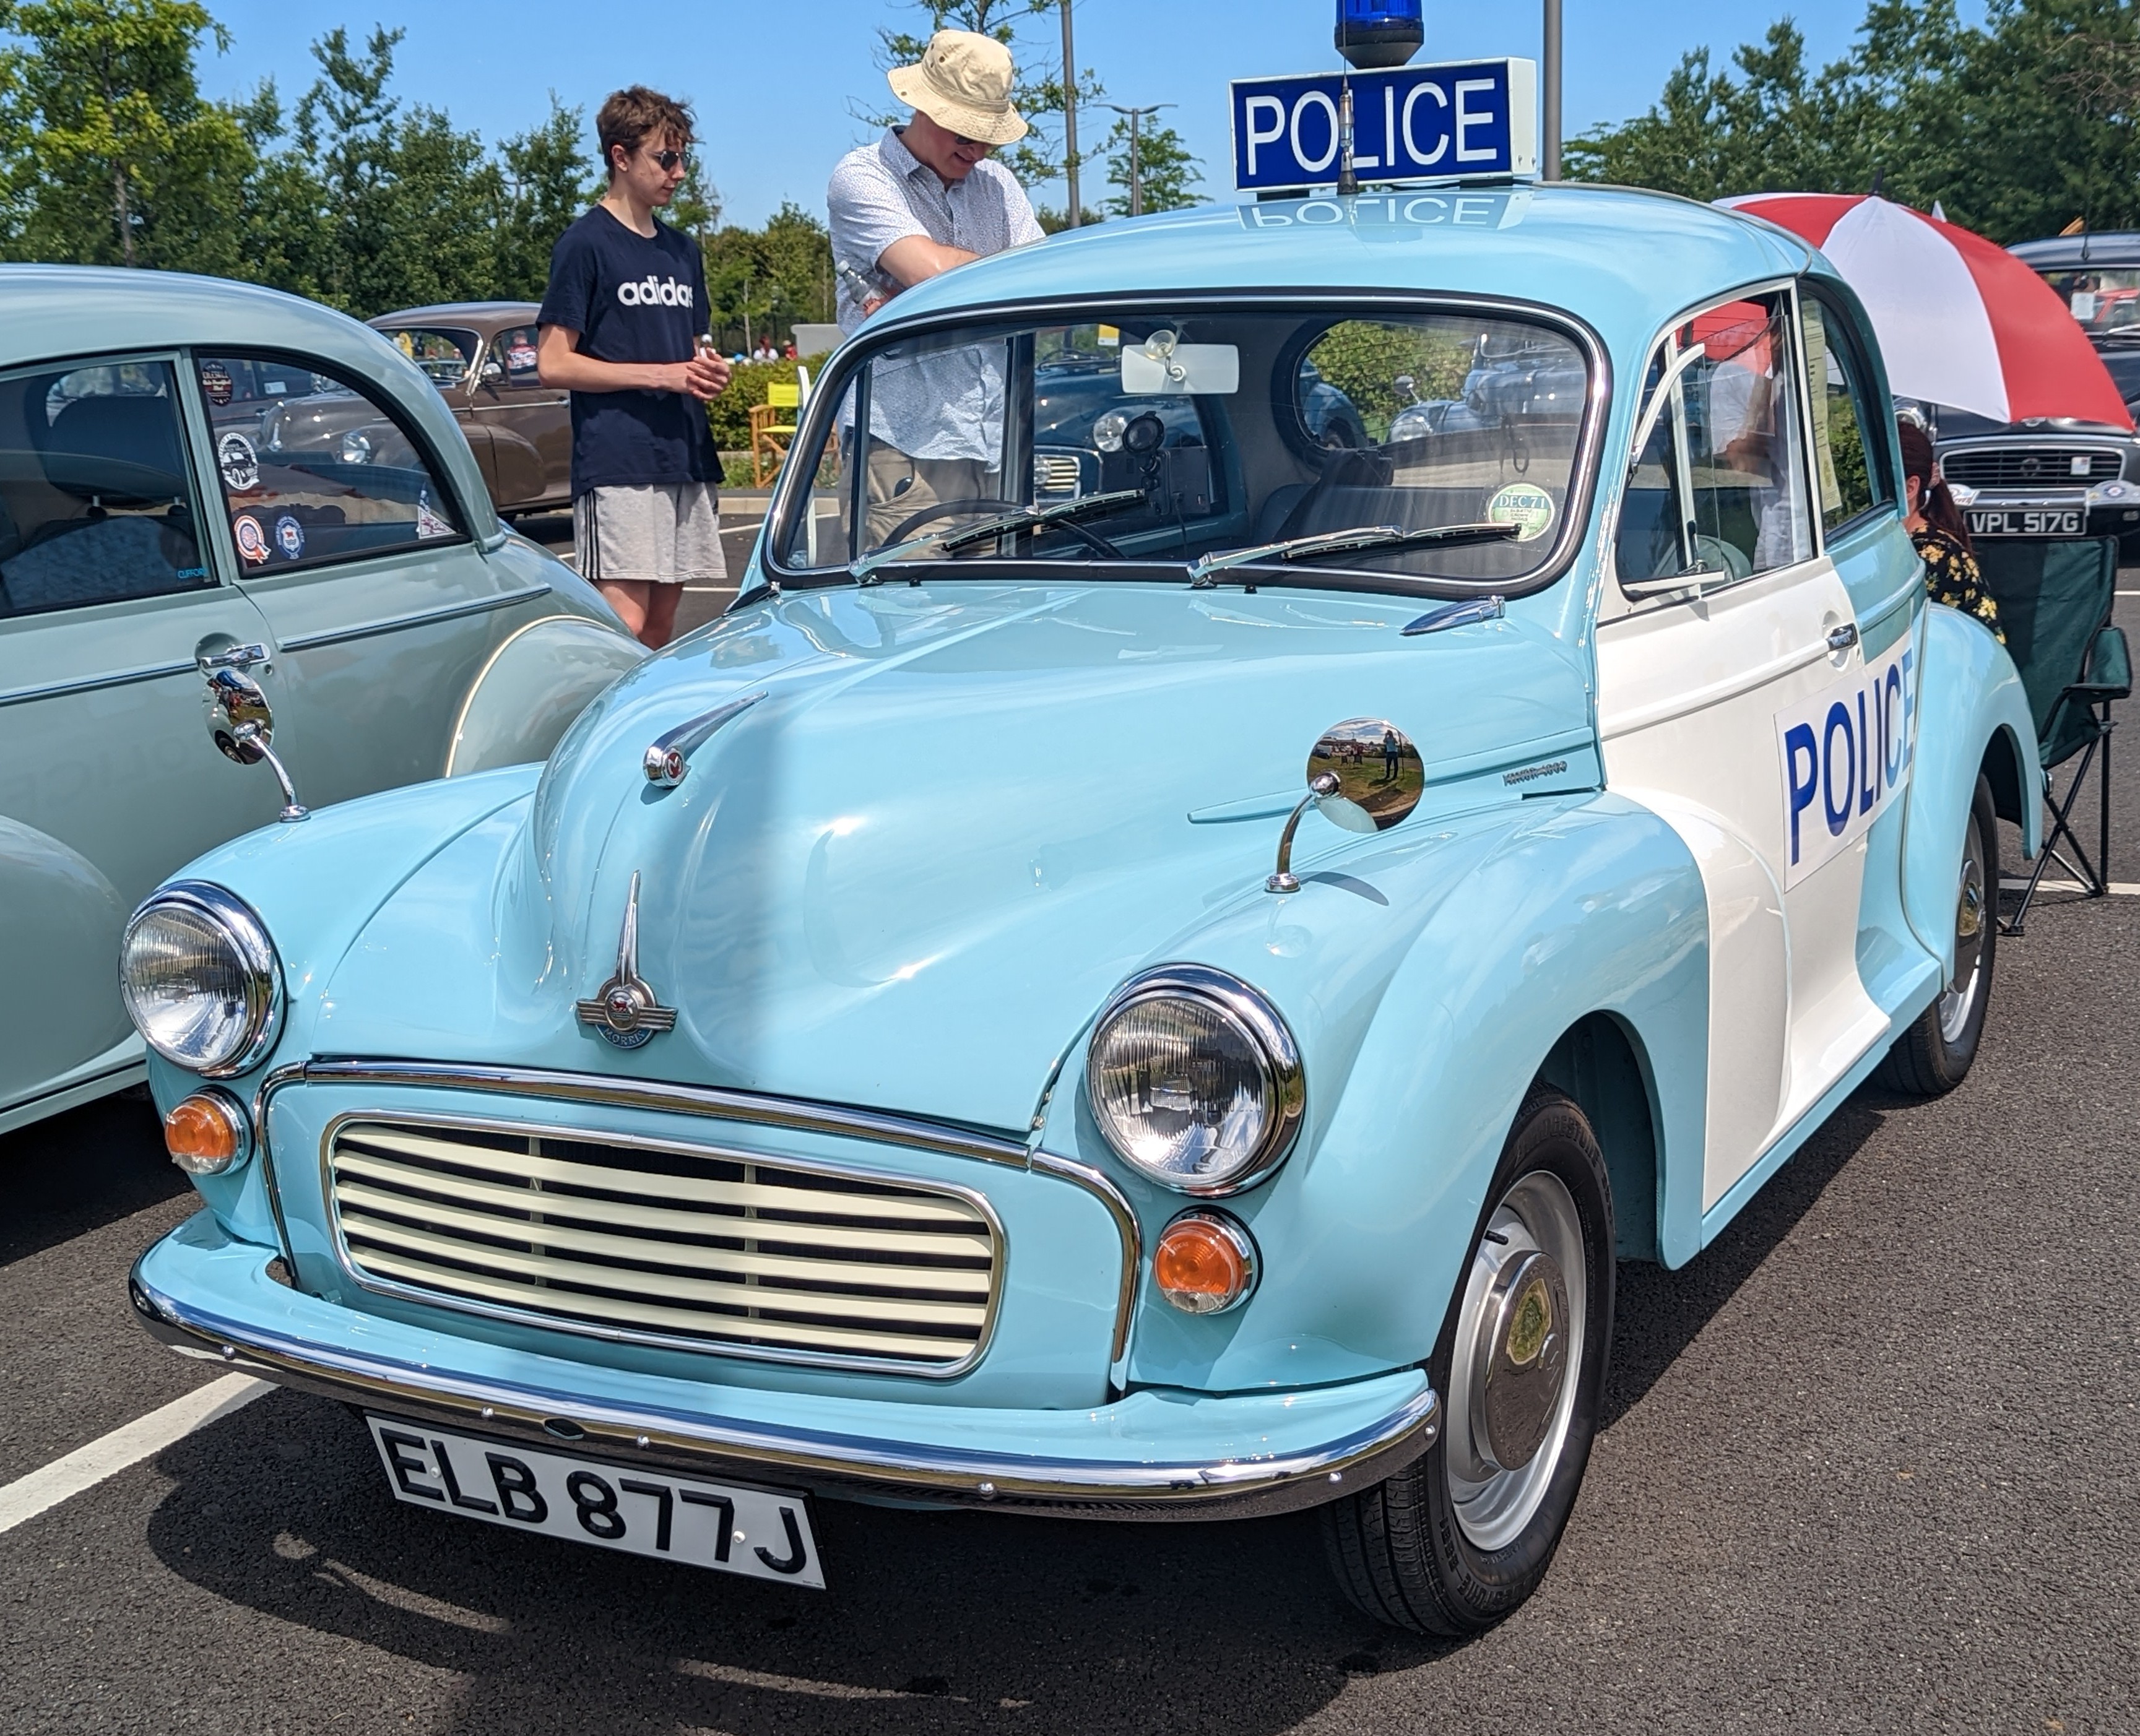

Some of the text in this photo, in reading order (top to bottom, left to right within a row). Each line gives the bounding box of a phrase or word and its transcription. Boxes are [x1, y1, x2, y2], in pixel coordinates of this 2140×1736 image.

[1245, 78, 1497, 176] POLICE
[1499, 495, 1546, 509] DEC 71
[1971, 512, 2079, 533] VPL 517G
[667, 756, 682, 775] M
[1784, 647, 1914, 866] POLICE
[604, 1027, 645, 1046] MORRIS
[379, 1427, 806, 1574] ELB 877J
